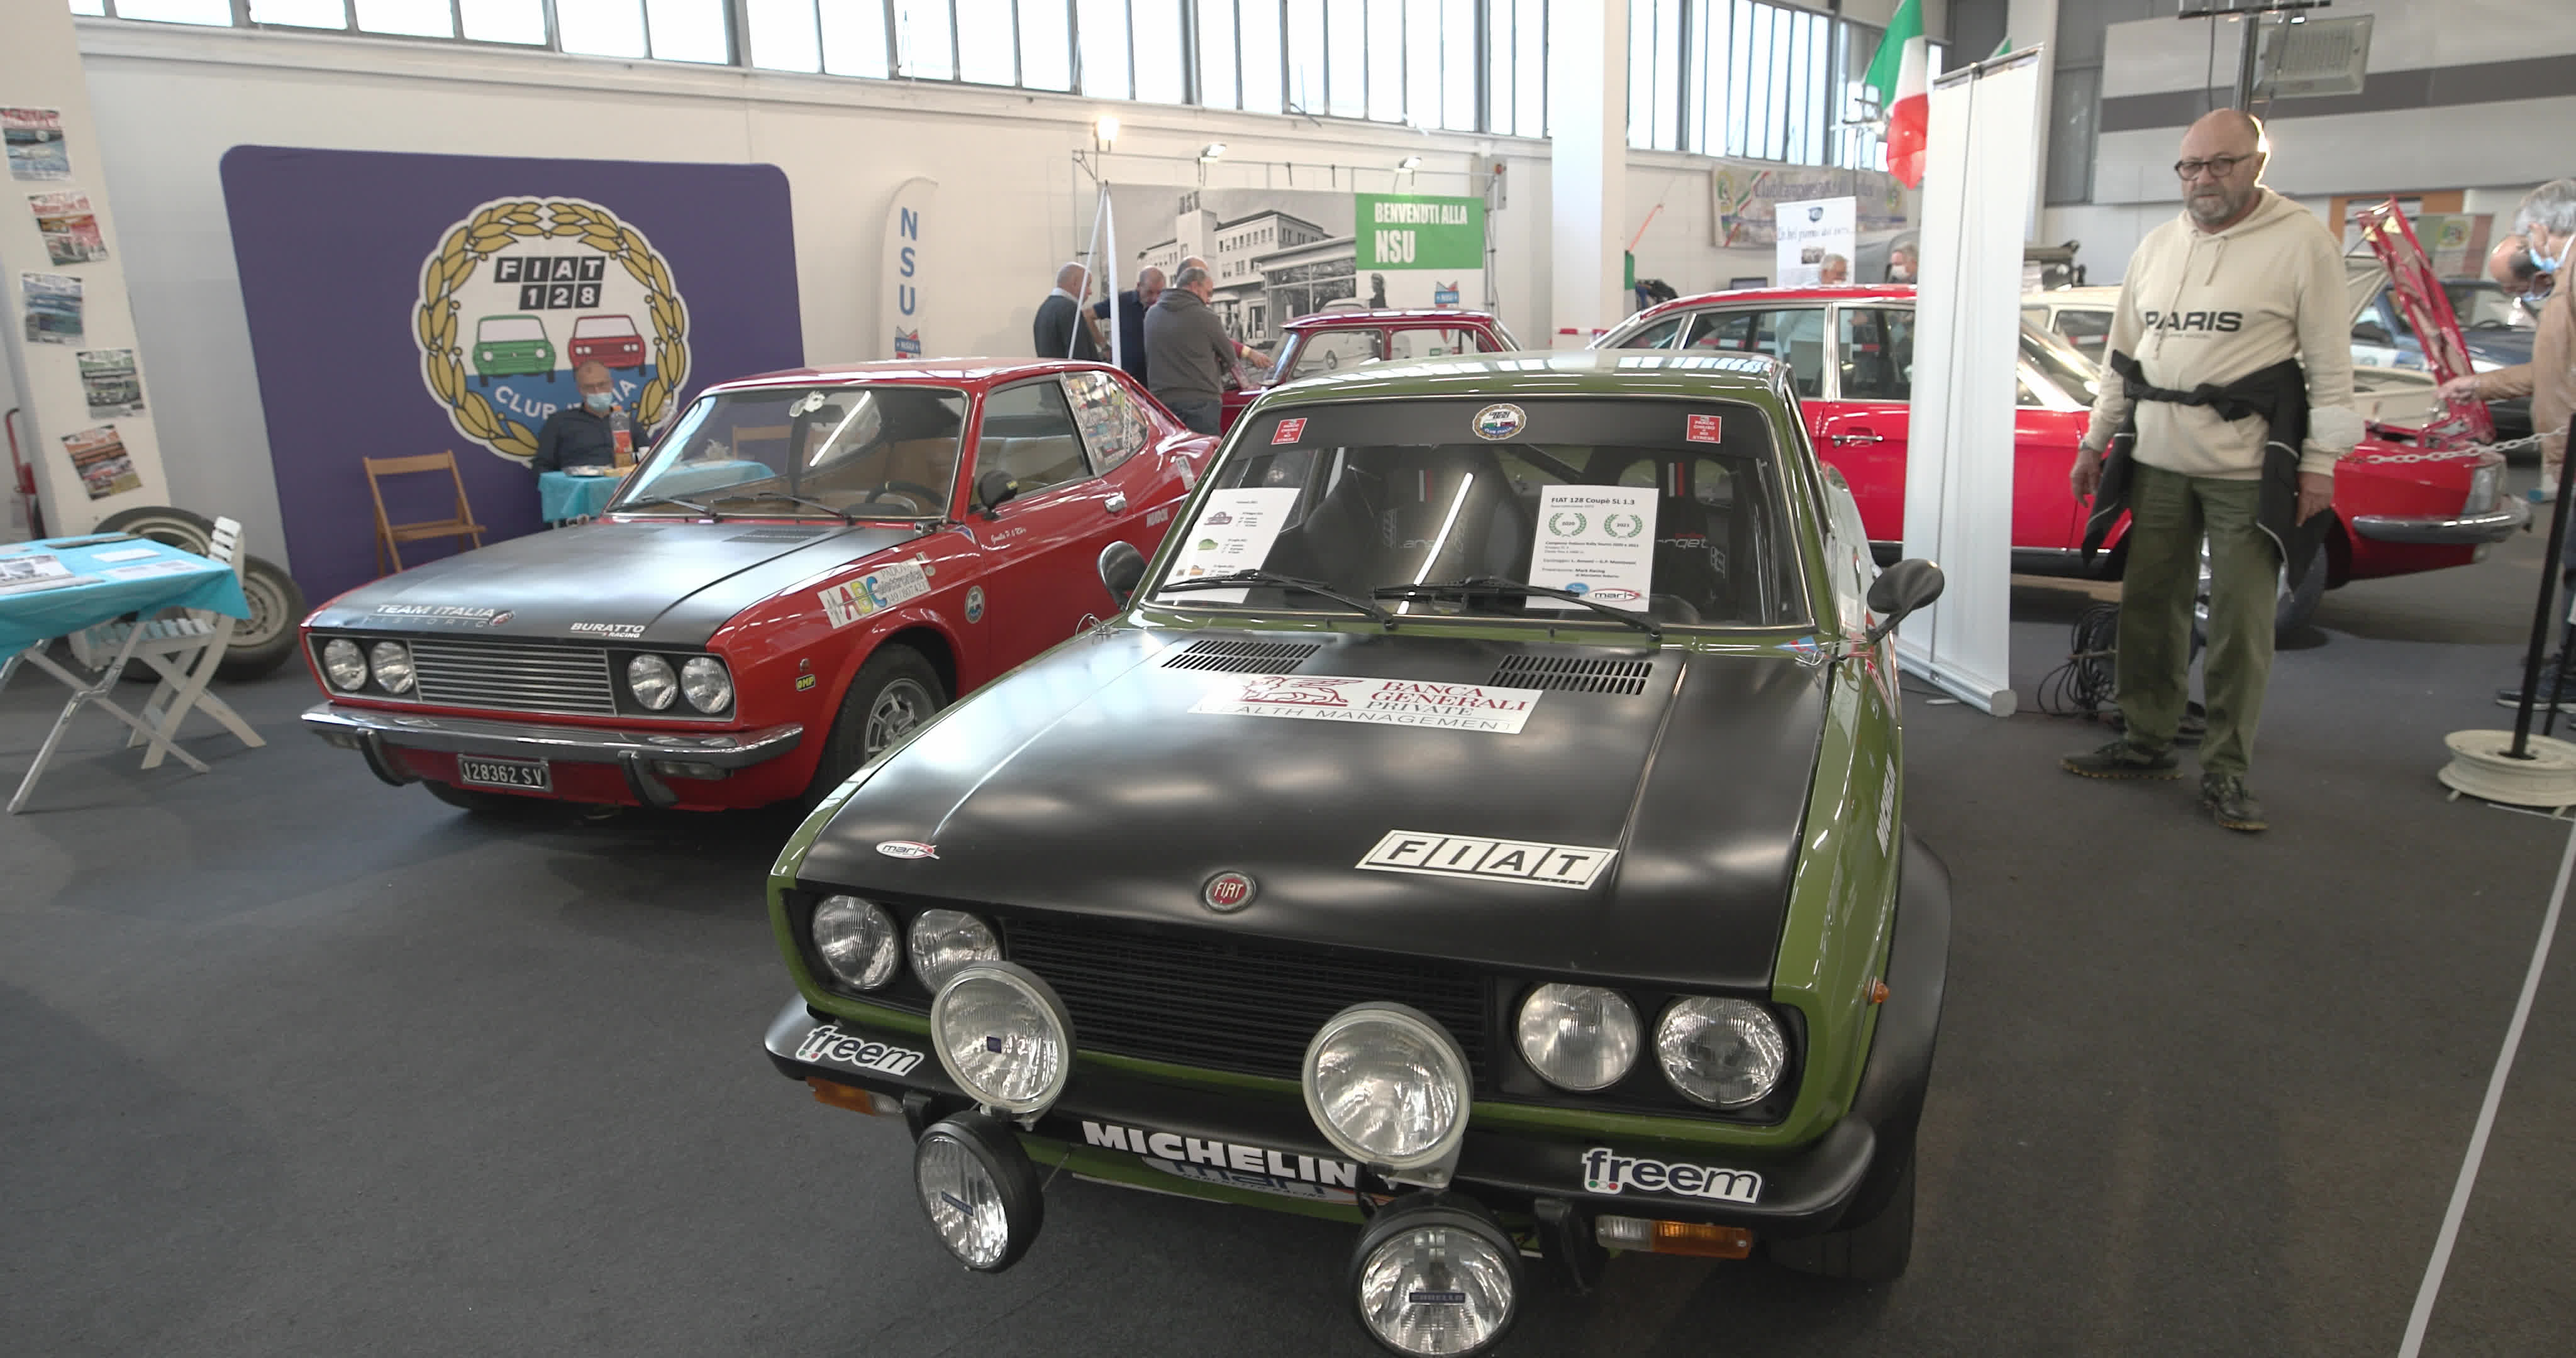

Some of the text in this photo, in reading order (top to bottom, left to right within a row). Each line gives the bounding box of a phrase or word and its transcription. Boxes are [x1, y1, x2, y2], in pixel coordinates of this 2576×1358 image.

[1375, 202, 1468, 224] BENVENUTI ALLA
[1375, 229, 1416, 263] NSU
[500, 260, 601, 280] FIAT
[900, 206, 918, 316] NSU
[528, 287, 595, 306] 128
[2145, 311, 2243, 332] PARIS
[840, 576, 887, 621] ABC
[377, 604, 495, 617] TEAM ITALIA
[570, 622, 646, 632] BURATTO
[797, 676, 814, 690] OMP
[1379, 682, 1484, 697] BANCA
[1363, 700, 1475, 716] PRIVATE
[1370, 692, 1530, 711] GENERALI
[521, 768, 542, 785] SV
[1877, 753, 1896, 858] MICHELIN
[1387, 840, 1589, 876] FIAT
[1214, 882, 1244, 899] FIAT
[804, 1027, 921, 1073] freem
[1082, 1120, 1358, 1189] MICHELIN
[1585, 1150, 1758, 1199] freem
